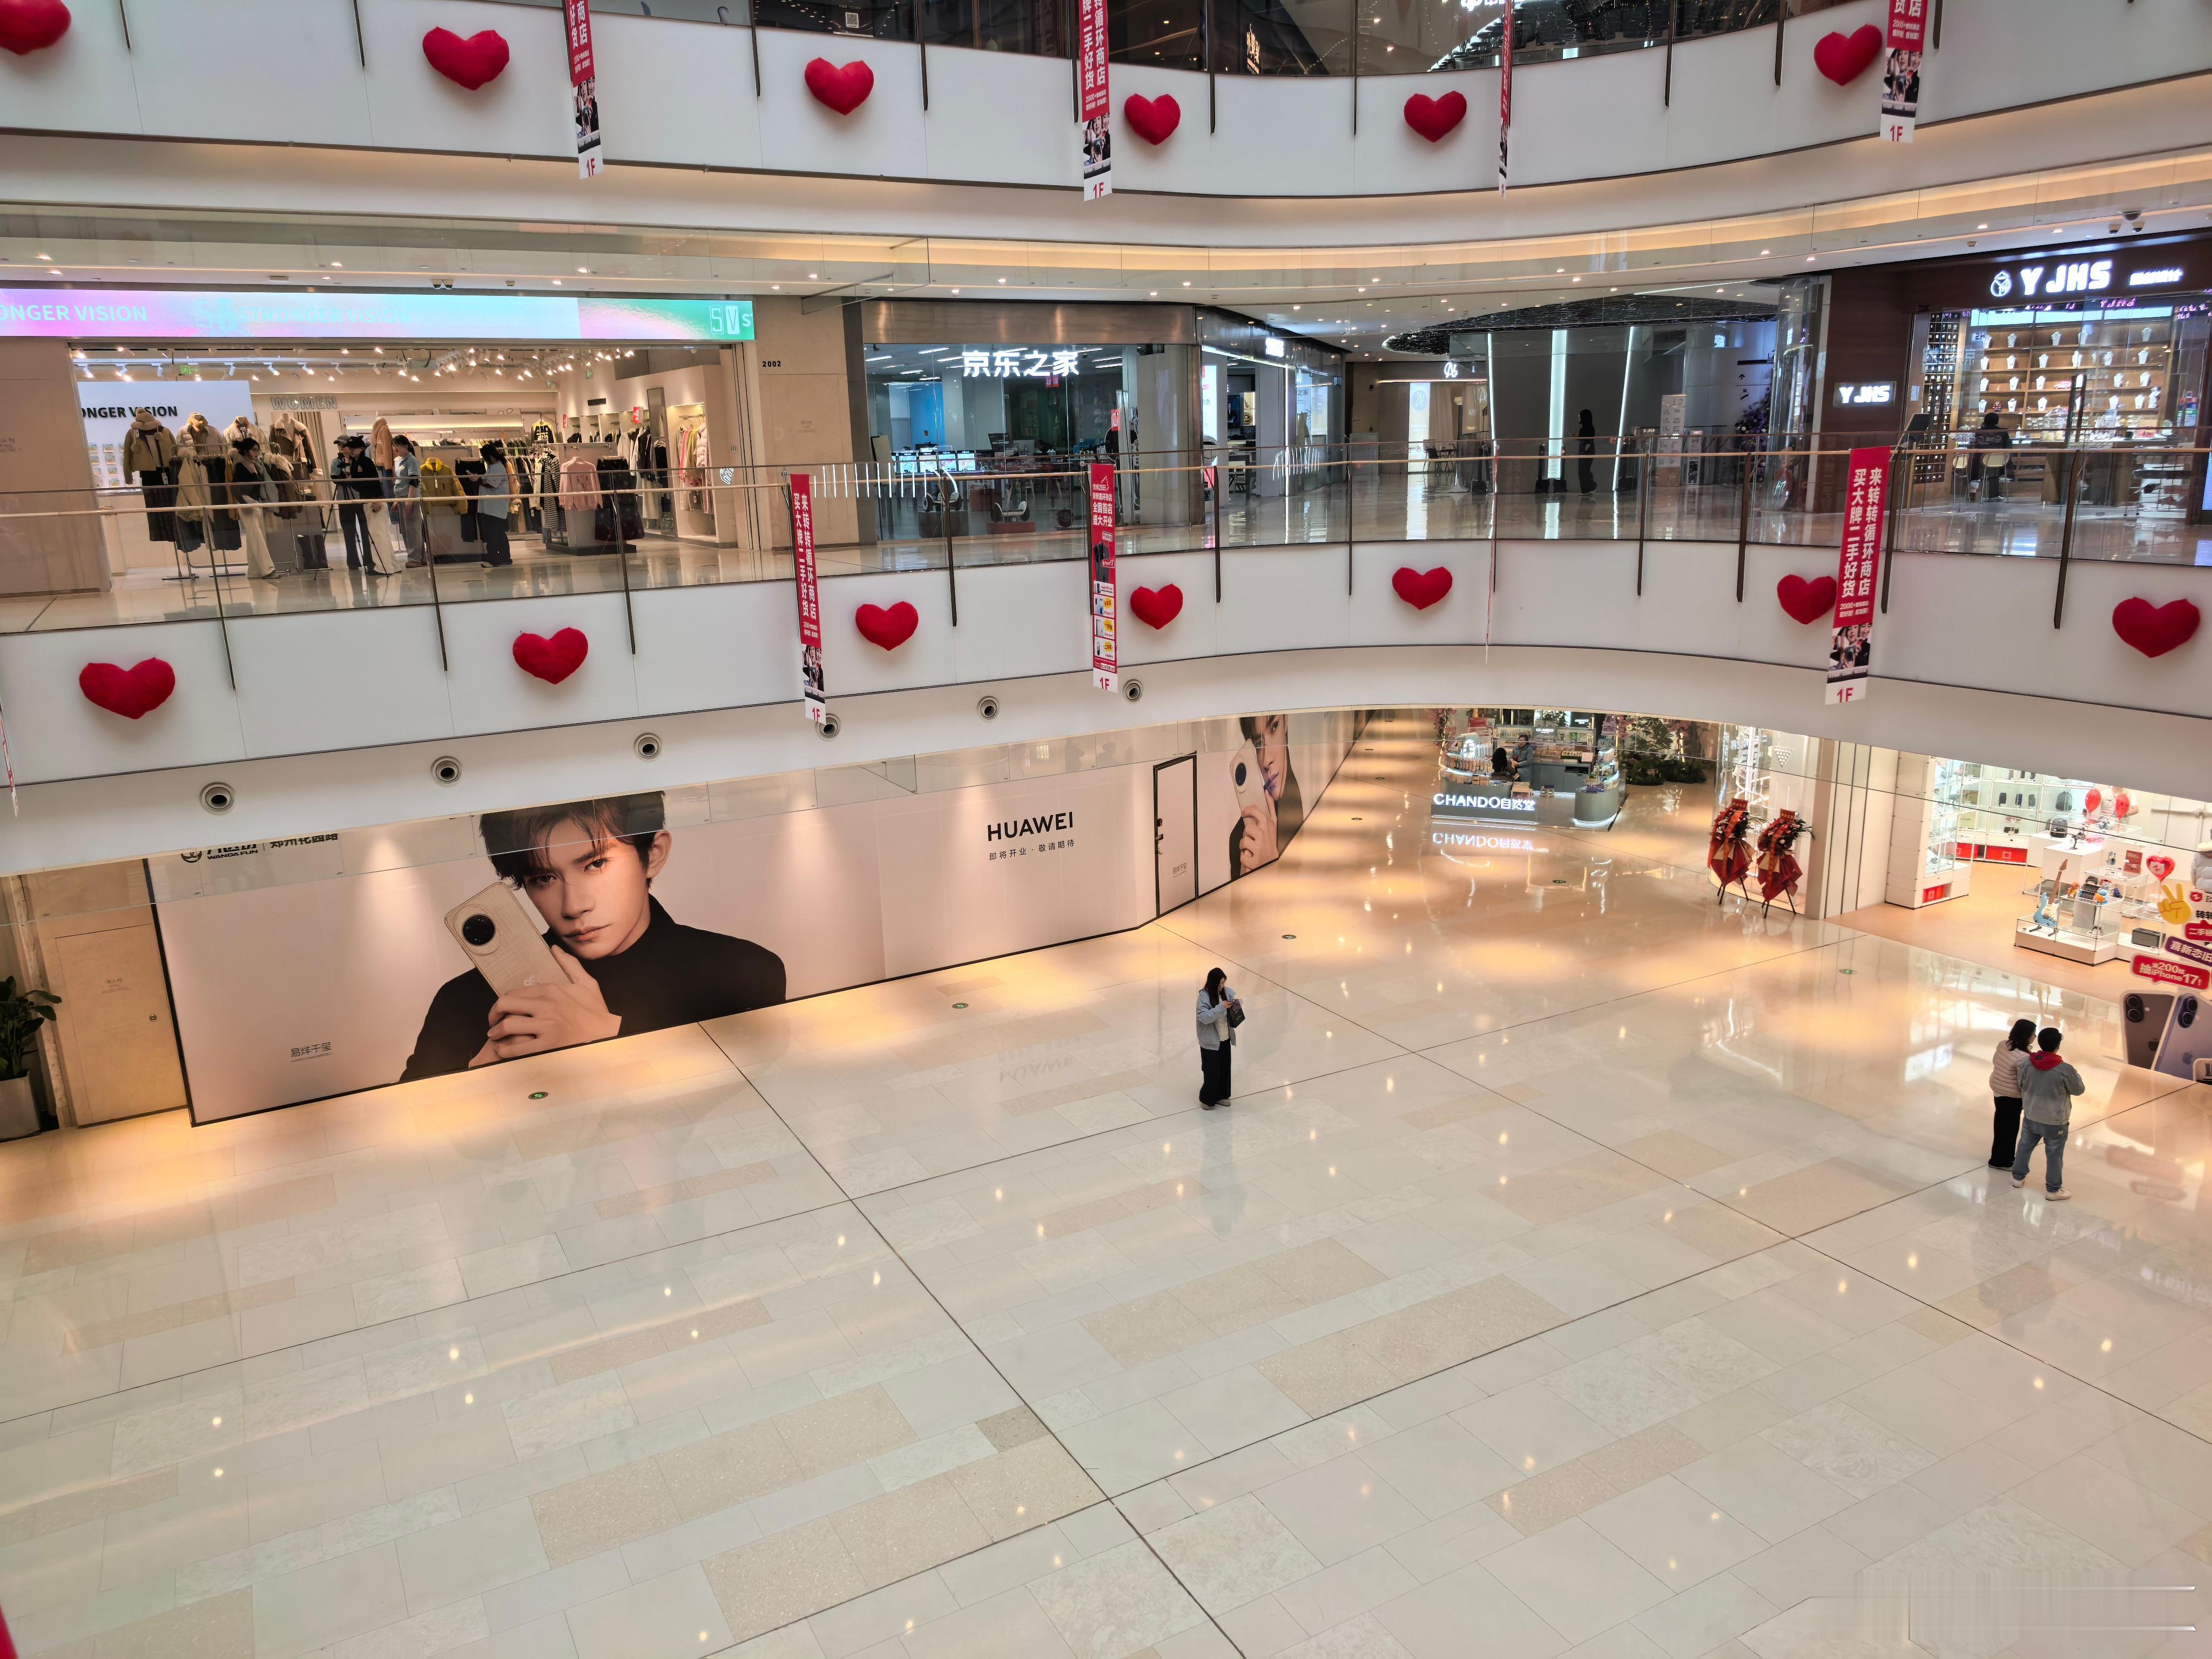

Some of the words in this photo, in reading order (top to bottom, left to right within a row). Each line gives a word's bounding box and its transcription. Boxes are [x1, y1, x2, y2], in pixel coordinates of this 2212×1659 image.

[1890, 125, 1903, 143] 1F
[586, 158, 595, 177] 1F
[1093, 182, 1104, 199] 1F
[2020, 260, 2113, 296] YJHS
[73, 306, 147, 321] VISION
[742, 312, 755, 327] S
[962, 350, 1079, 377] 京东之家
[271, 396, 338, 410] WOMEN
[1839, 385, 1890, 404] YJHS
[129, 406, 178, 417] VSION
[1092, 502, 1112, 515] 全国首店
[1092, 515, 1112, 527] 盛大开业
[1842, 468, 1866, 598] 买大牌二手好货
[1858, 467, 1882, 597] 来转转循环商店
[794, 493, 808, 617] 买大牌二手好货
[801, 494, 816, 620] 来转转循环商店
[1100, 676, 1110, 691] 1F
[1837, 687, 1853, 704] 1F
[812, 707, 820, 722] 1F
[1433, 793, 1535, 811] CHANDO自然堂
[988, 811, 1073, 841] HUAWEI
